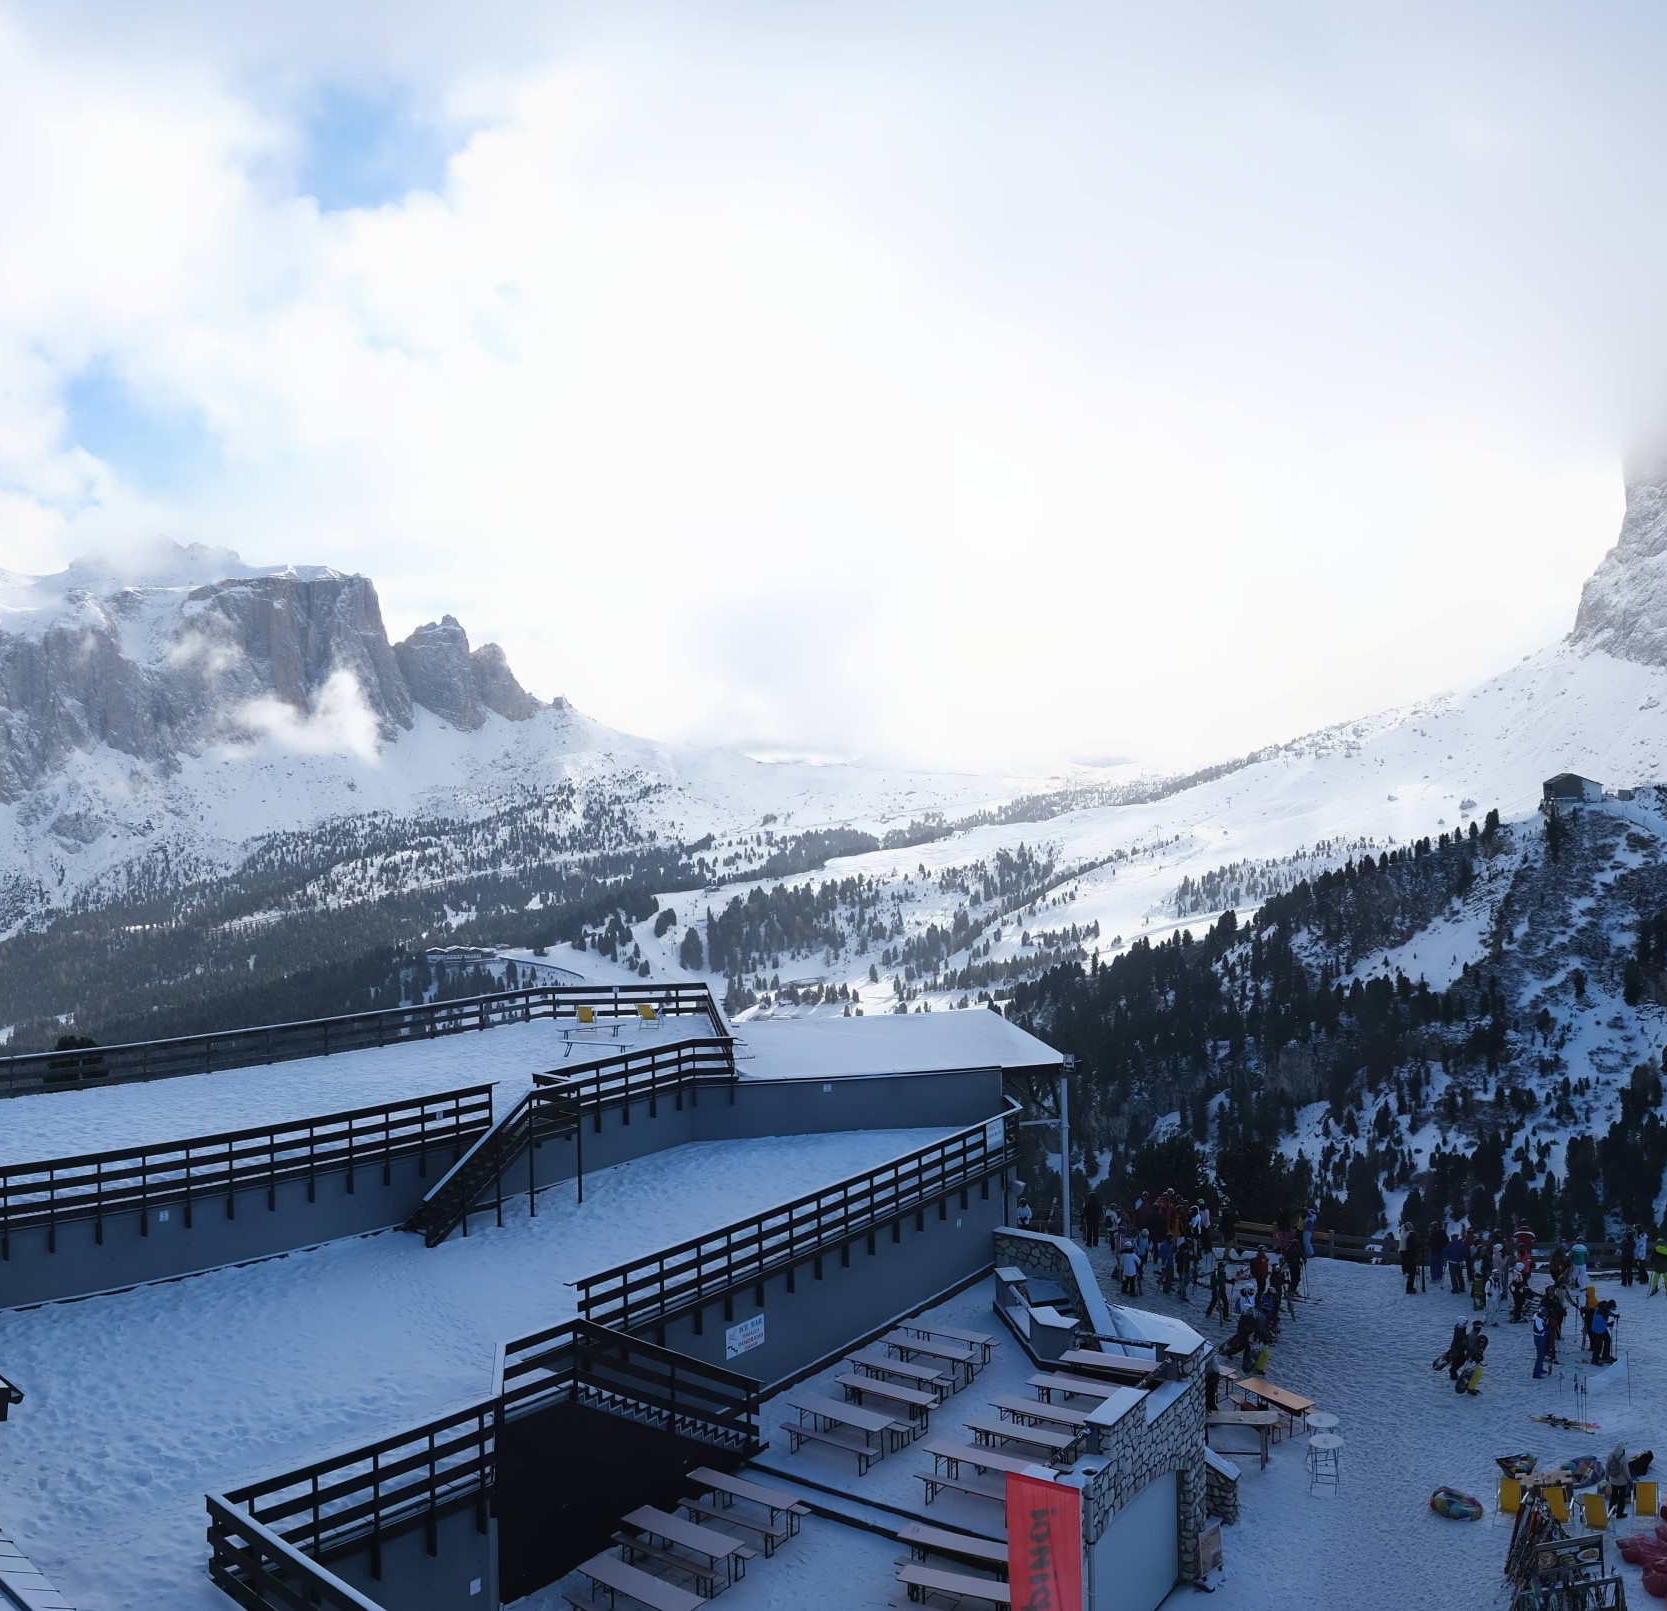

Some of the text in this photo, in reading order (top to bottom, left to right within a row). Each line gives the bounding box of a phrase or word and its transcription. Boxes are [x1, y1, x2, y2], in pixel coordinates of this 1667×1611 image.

[739, 1318, 762, 1333] ICE BAR
[738, 1332, 763, 1347] PANORAMA
